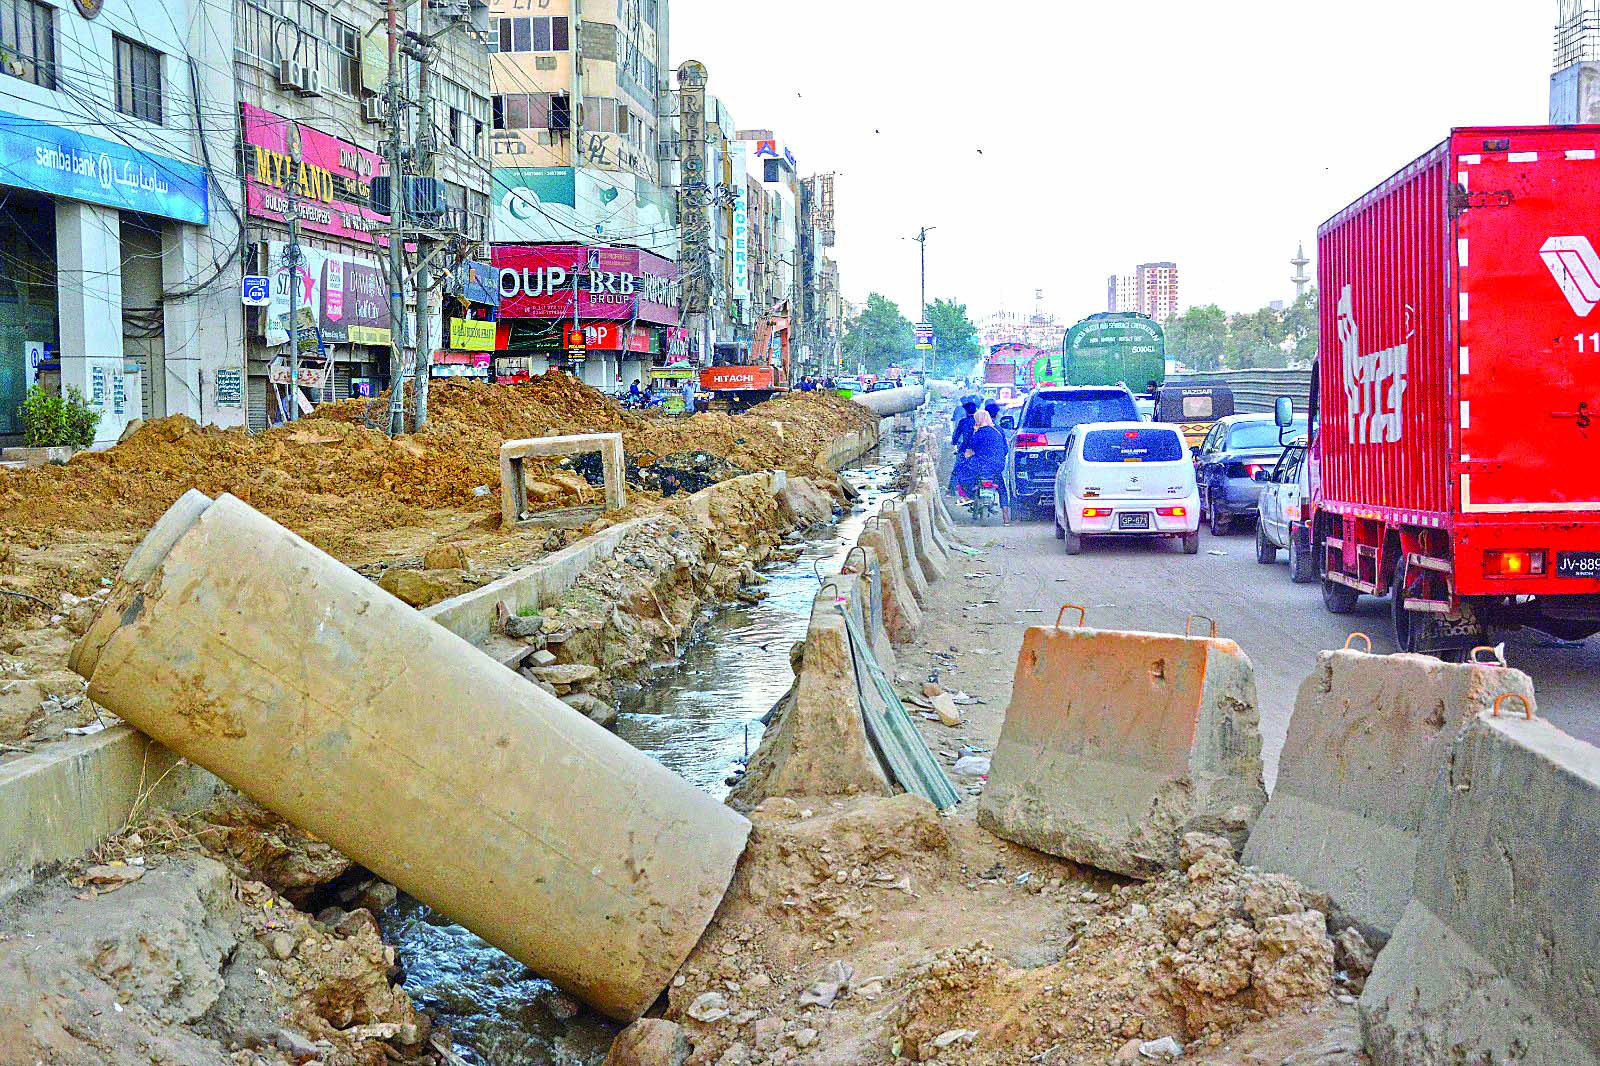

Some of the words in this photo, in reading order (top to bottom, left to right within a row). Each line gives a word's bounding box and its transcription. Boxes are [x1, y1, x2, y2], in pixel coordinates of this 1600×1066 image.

[35, 145, 72, 173] samba
[72, 149, 97, 179] bank
[255, 147, 284, 187] MY
[284, 155, 334, 204] LAND
[265, 193, 290, 214] BUILDER
[733, 187, 748, 289] PROPERTY
[499, 266, 567, 299] OUP
[589, 269, 634, 295] BRB
[590, 294, 630, 304] GROUP
[713, 374, 744, 383] HITACHI
